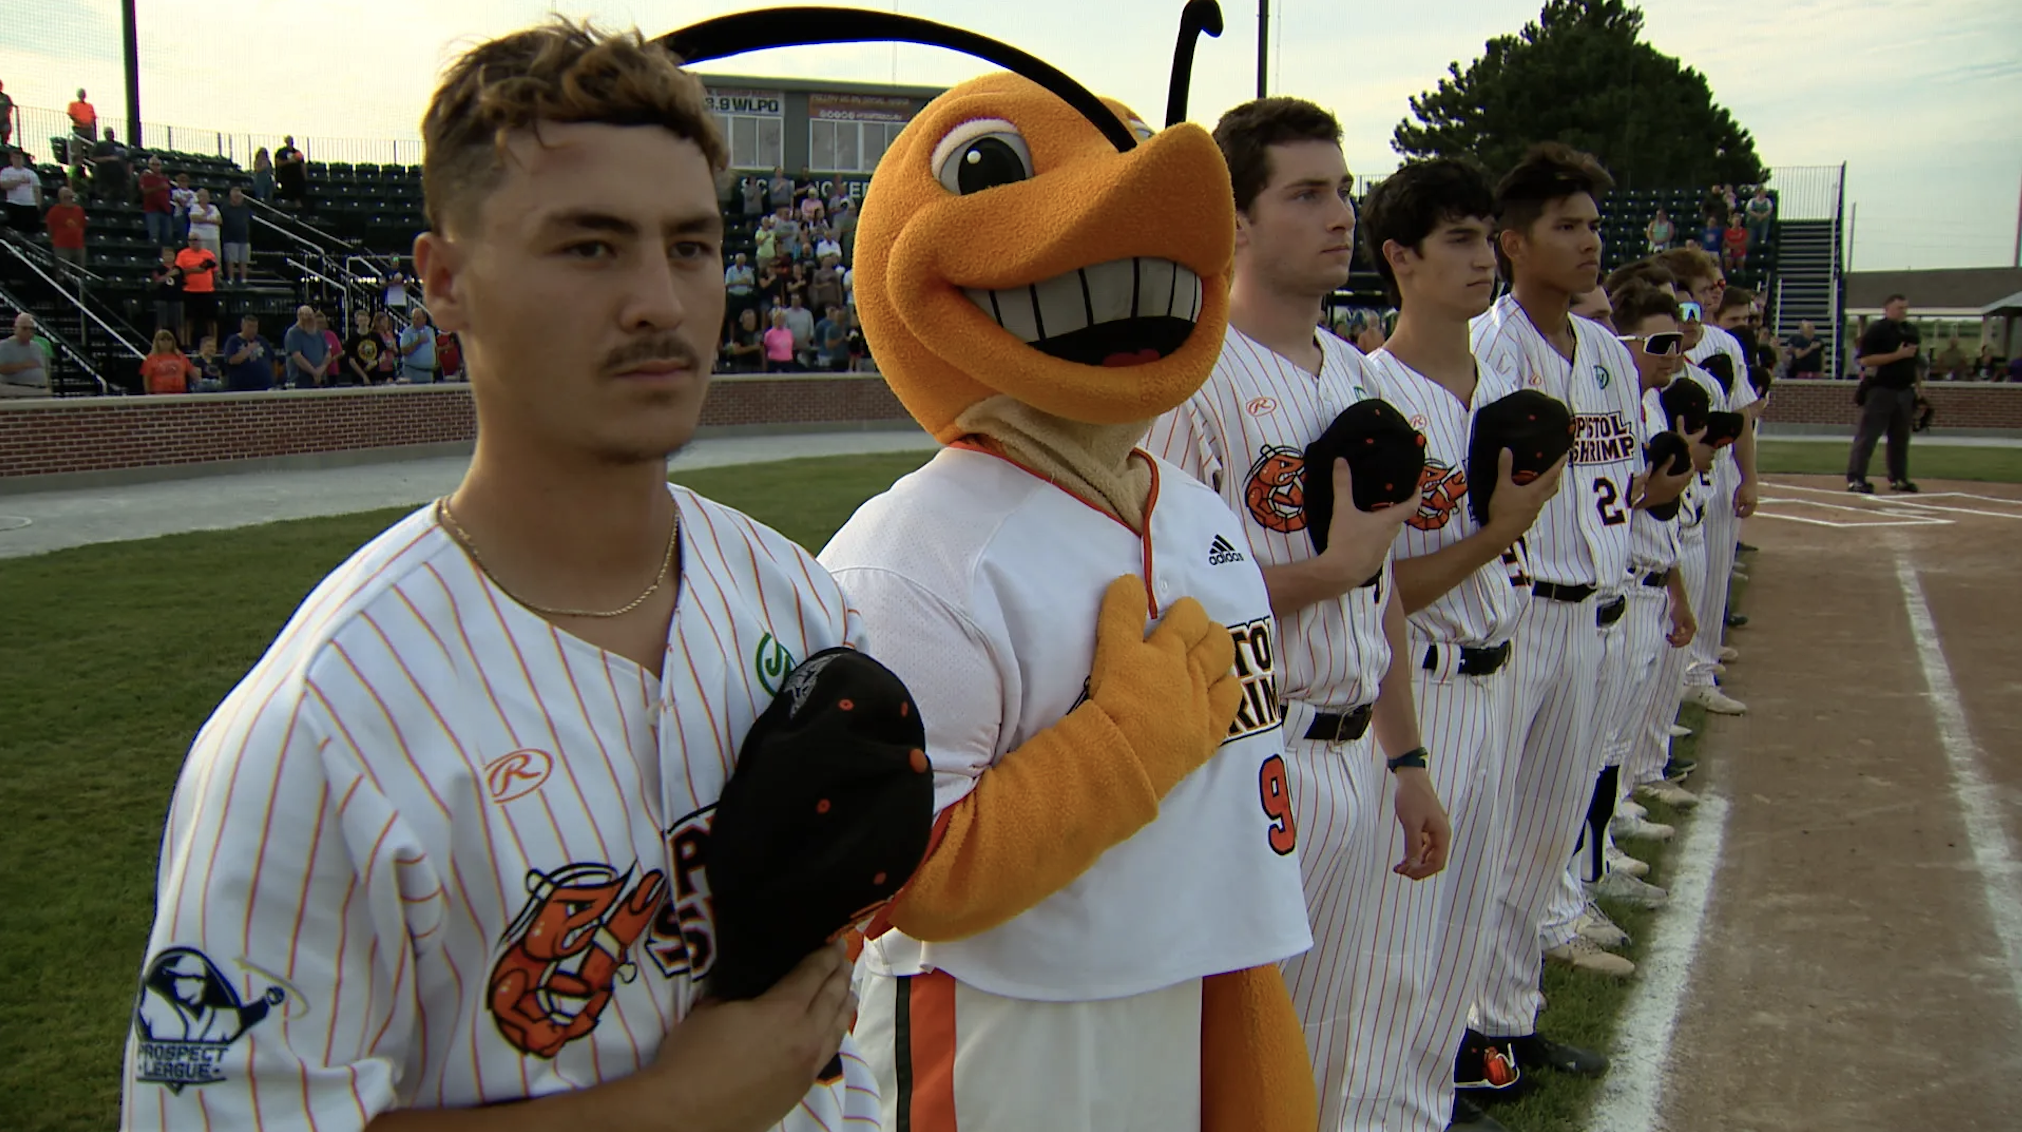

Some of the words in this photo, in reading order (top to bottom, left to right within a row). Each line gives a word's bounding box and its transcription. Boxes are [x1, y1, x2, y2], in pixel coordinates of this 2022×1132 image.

[732, 97, 778, 112] WLPO
[1573, 436, 1634, 462] SHRIMP
[1208, 552, 1244, 565] adidas
[1260, 753, 1296, 856] 9
[138, 1043, 229, 1063] PROSPECT
